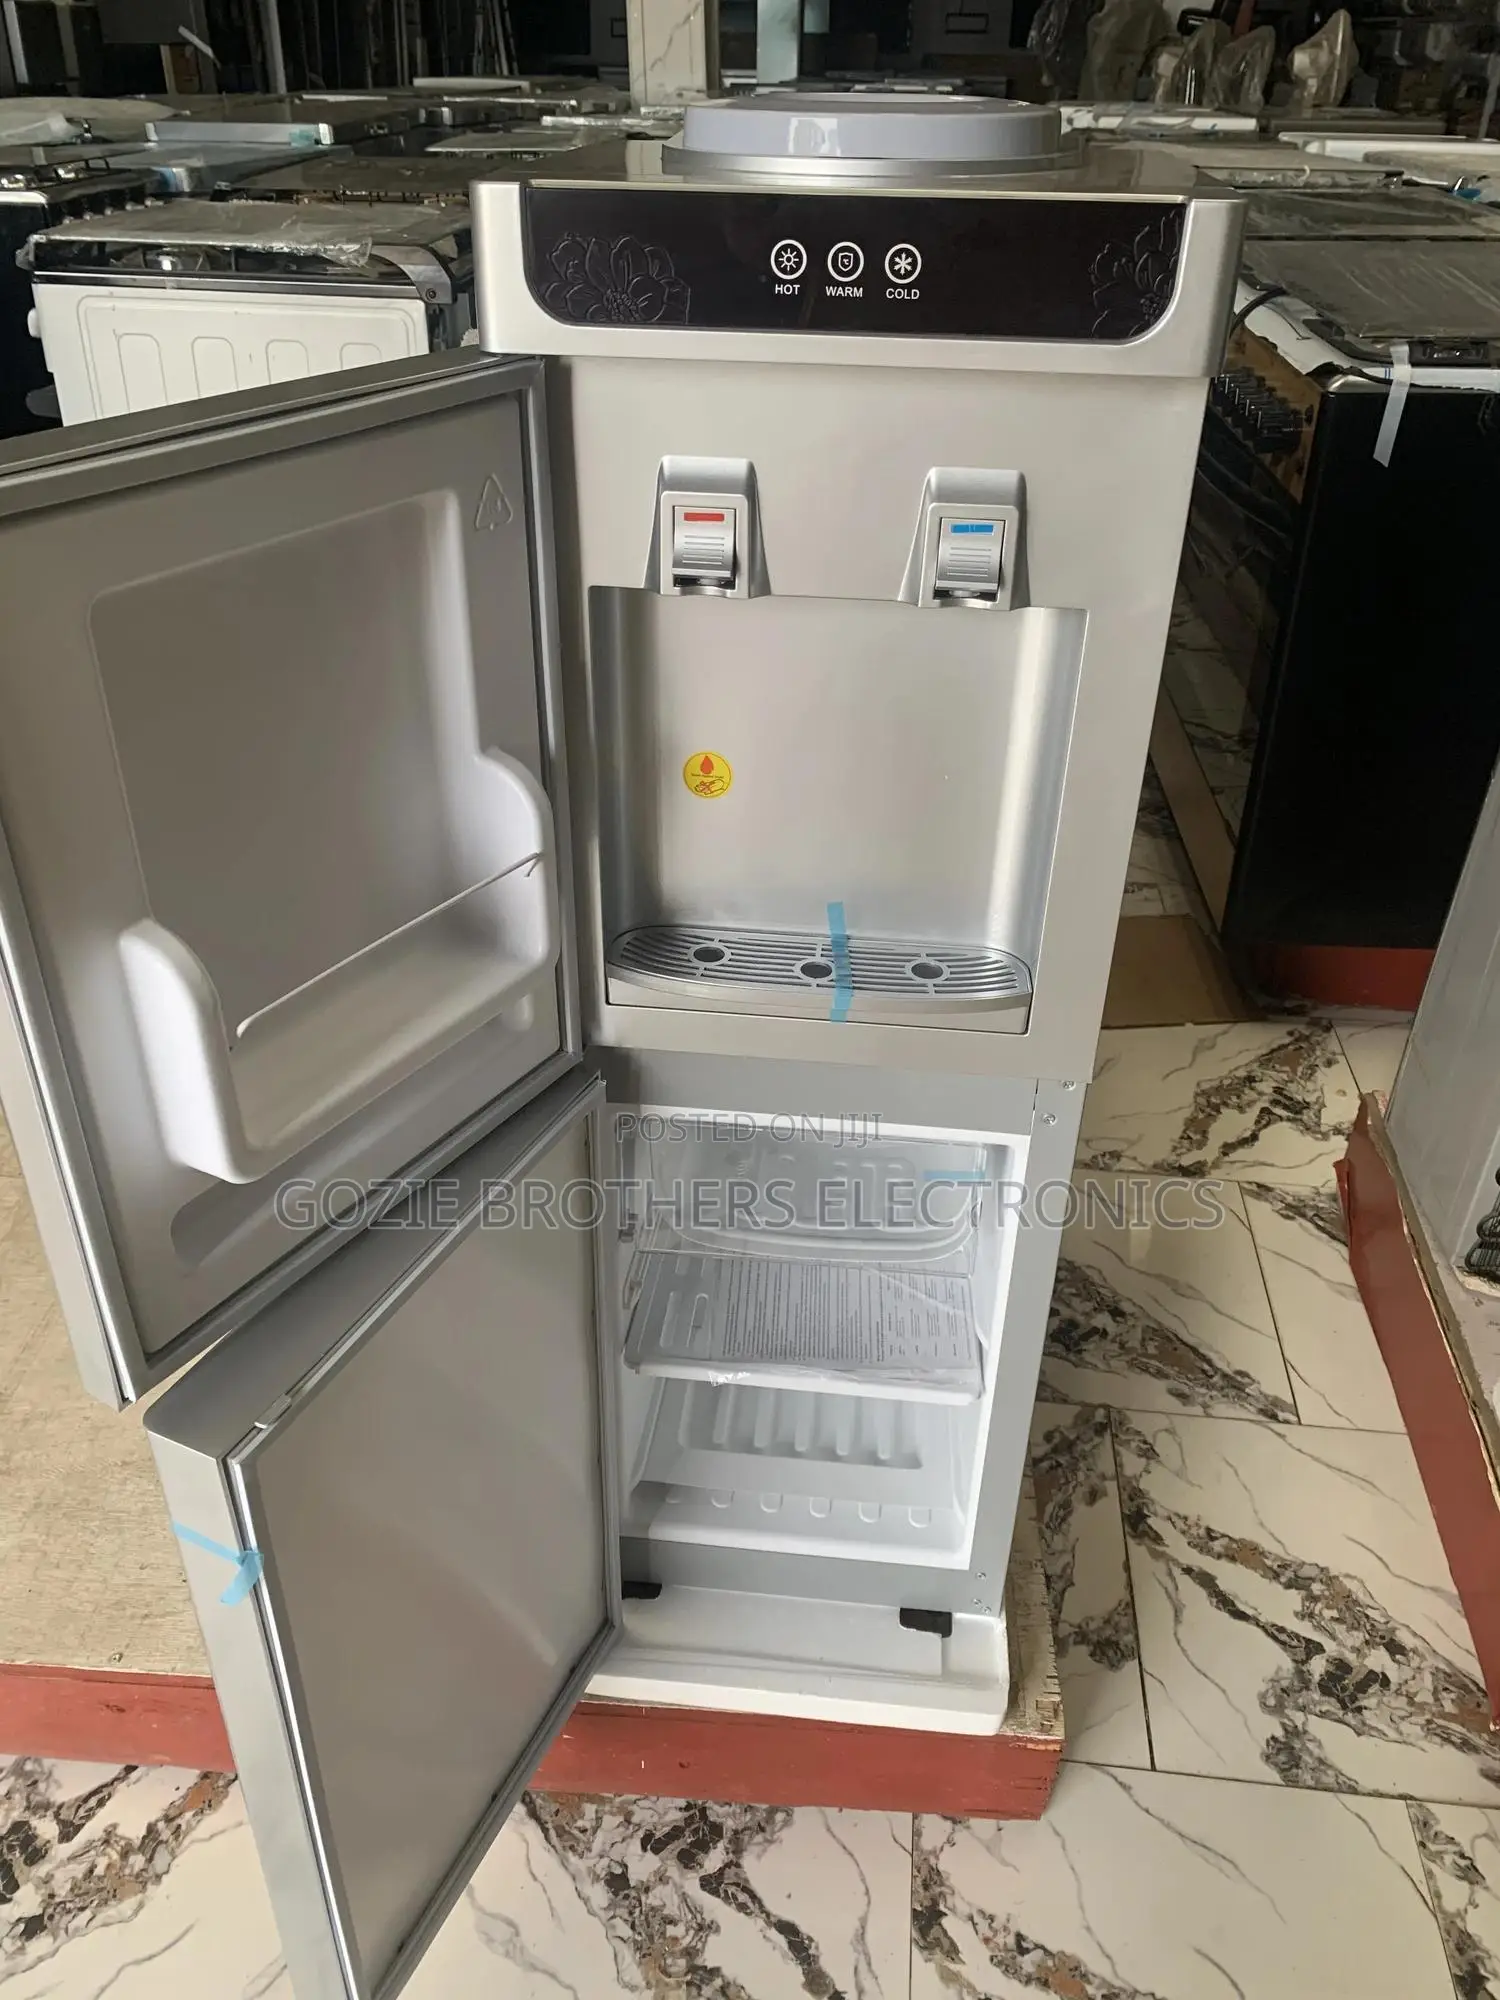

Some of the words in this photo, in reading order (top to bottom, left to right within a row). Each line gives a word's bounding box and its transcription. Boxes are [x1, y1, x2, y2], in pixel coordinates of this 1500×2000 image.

[775, 284, 800, 295] HOT
[825, 286, 863, 298] WARM
[886, 288, 920, 300] COLD
